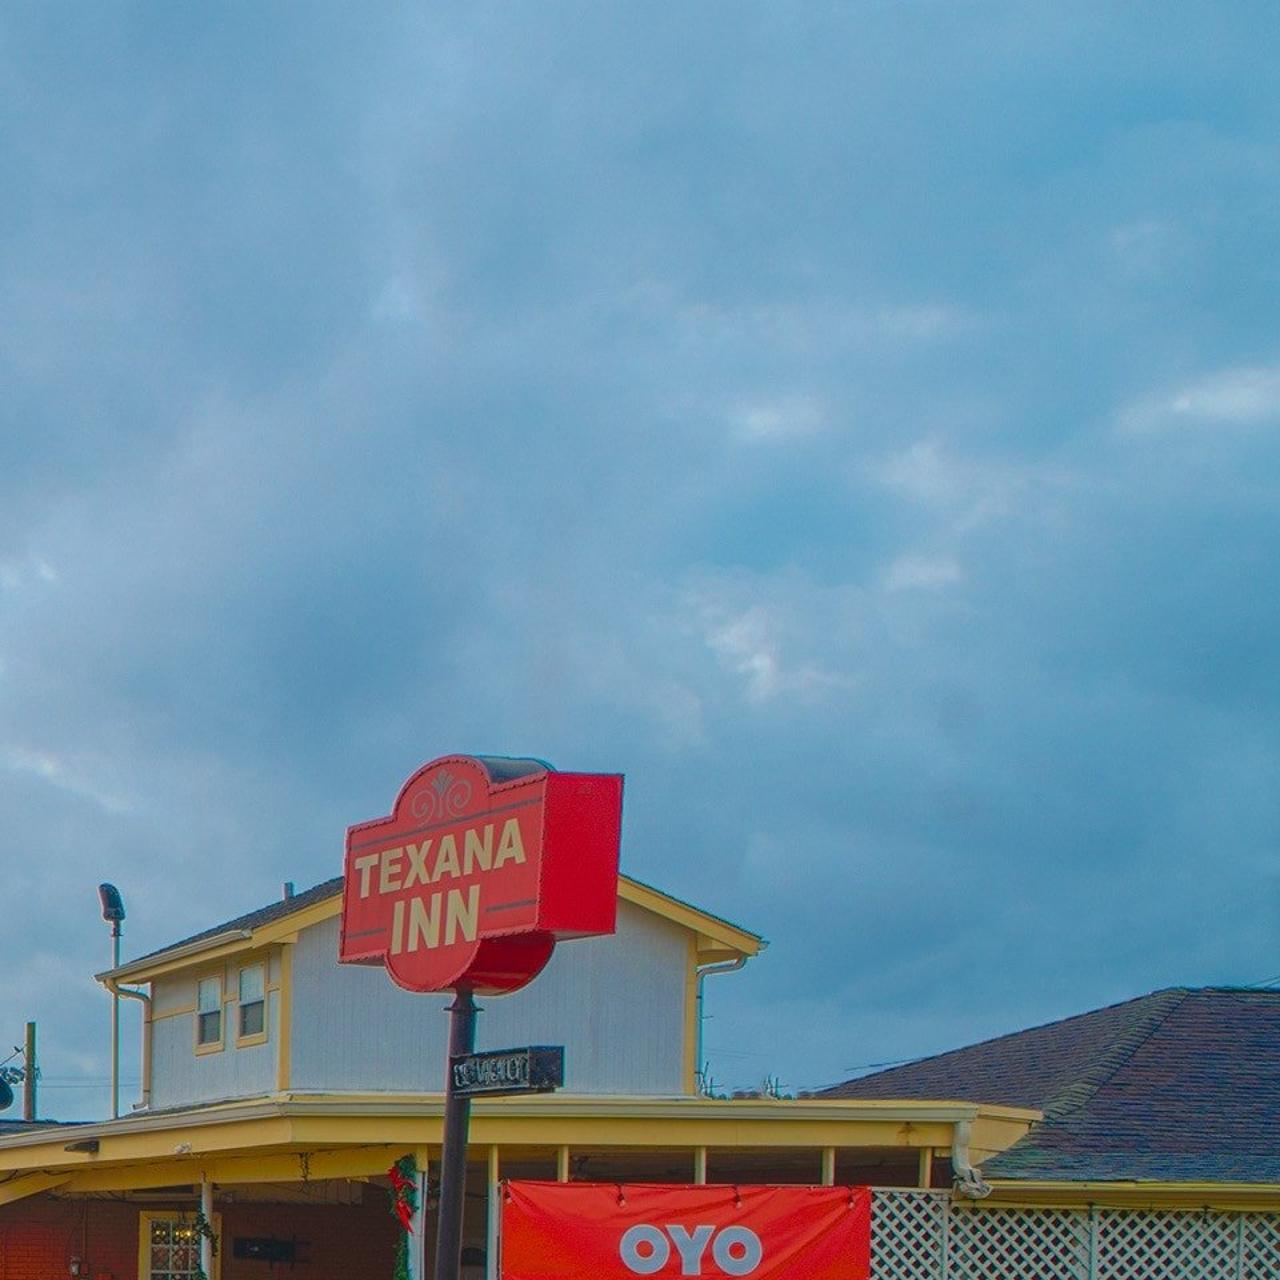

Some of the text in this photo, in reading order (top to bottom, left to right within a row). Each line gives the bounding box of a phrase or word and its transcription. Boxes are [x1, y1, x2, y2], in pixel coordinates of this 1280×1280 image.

[354, 818, 527, 899] TEXANA
[391, 884, 481, 956] INN
[618, 1223, 763, 1277] OYO
